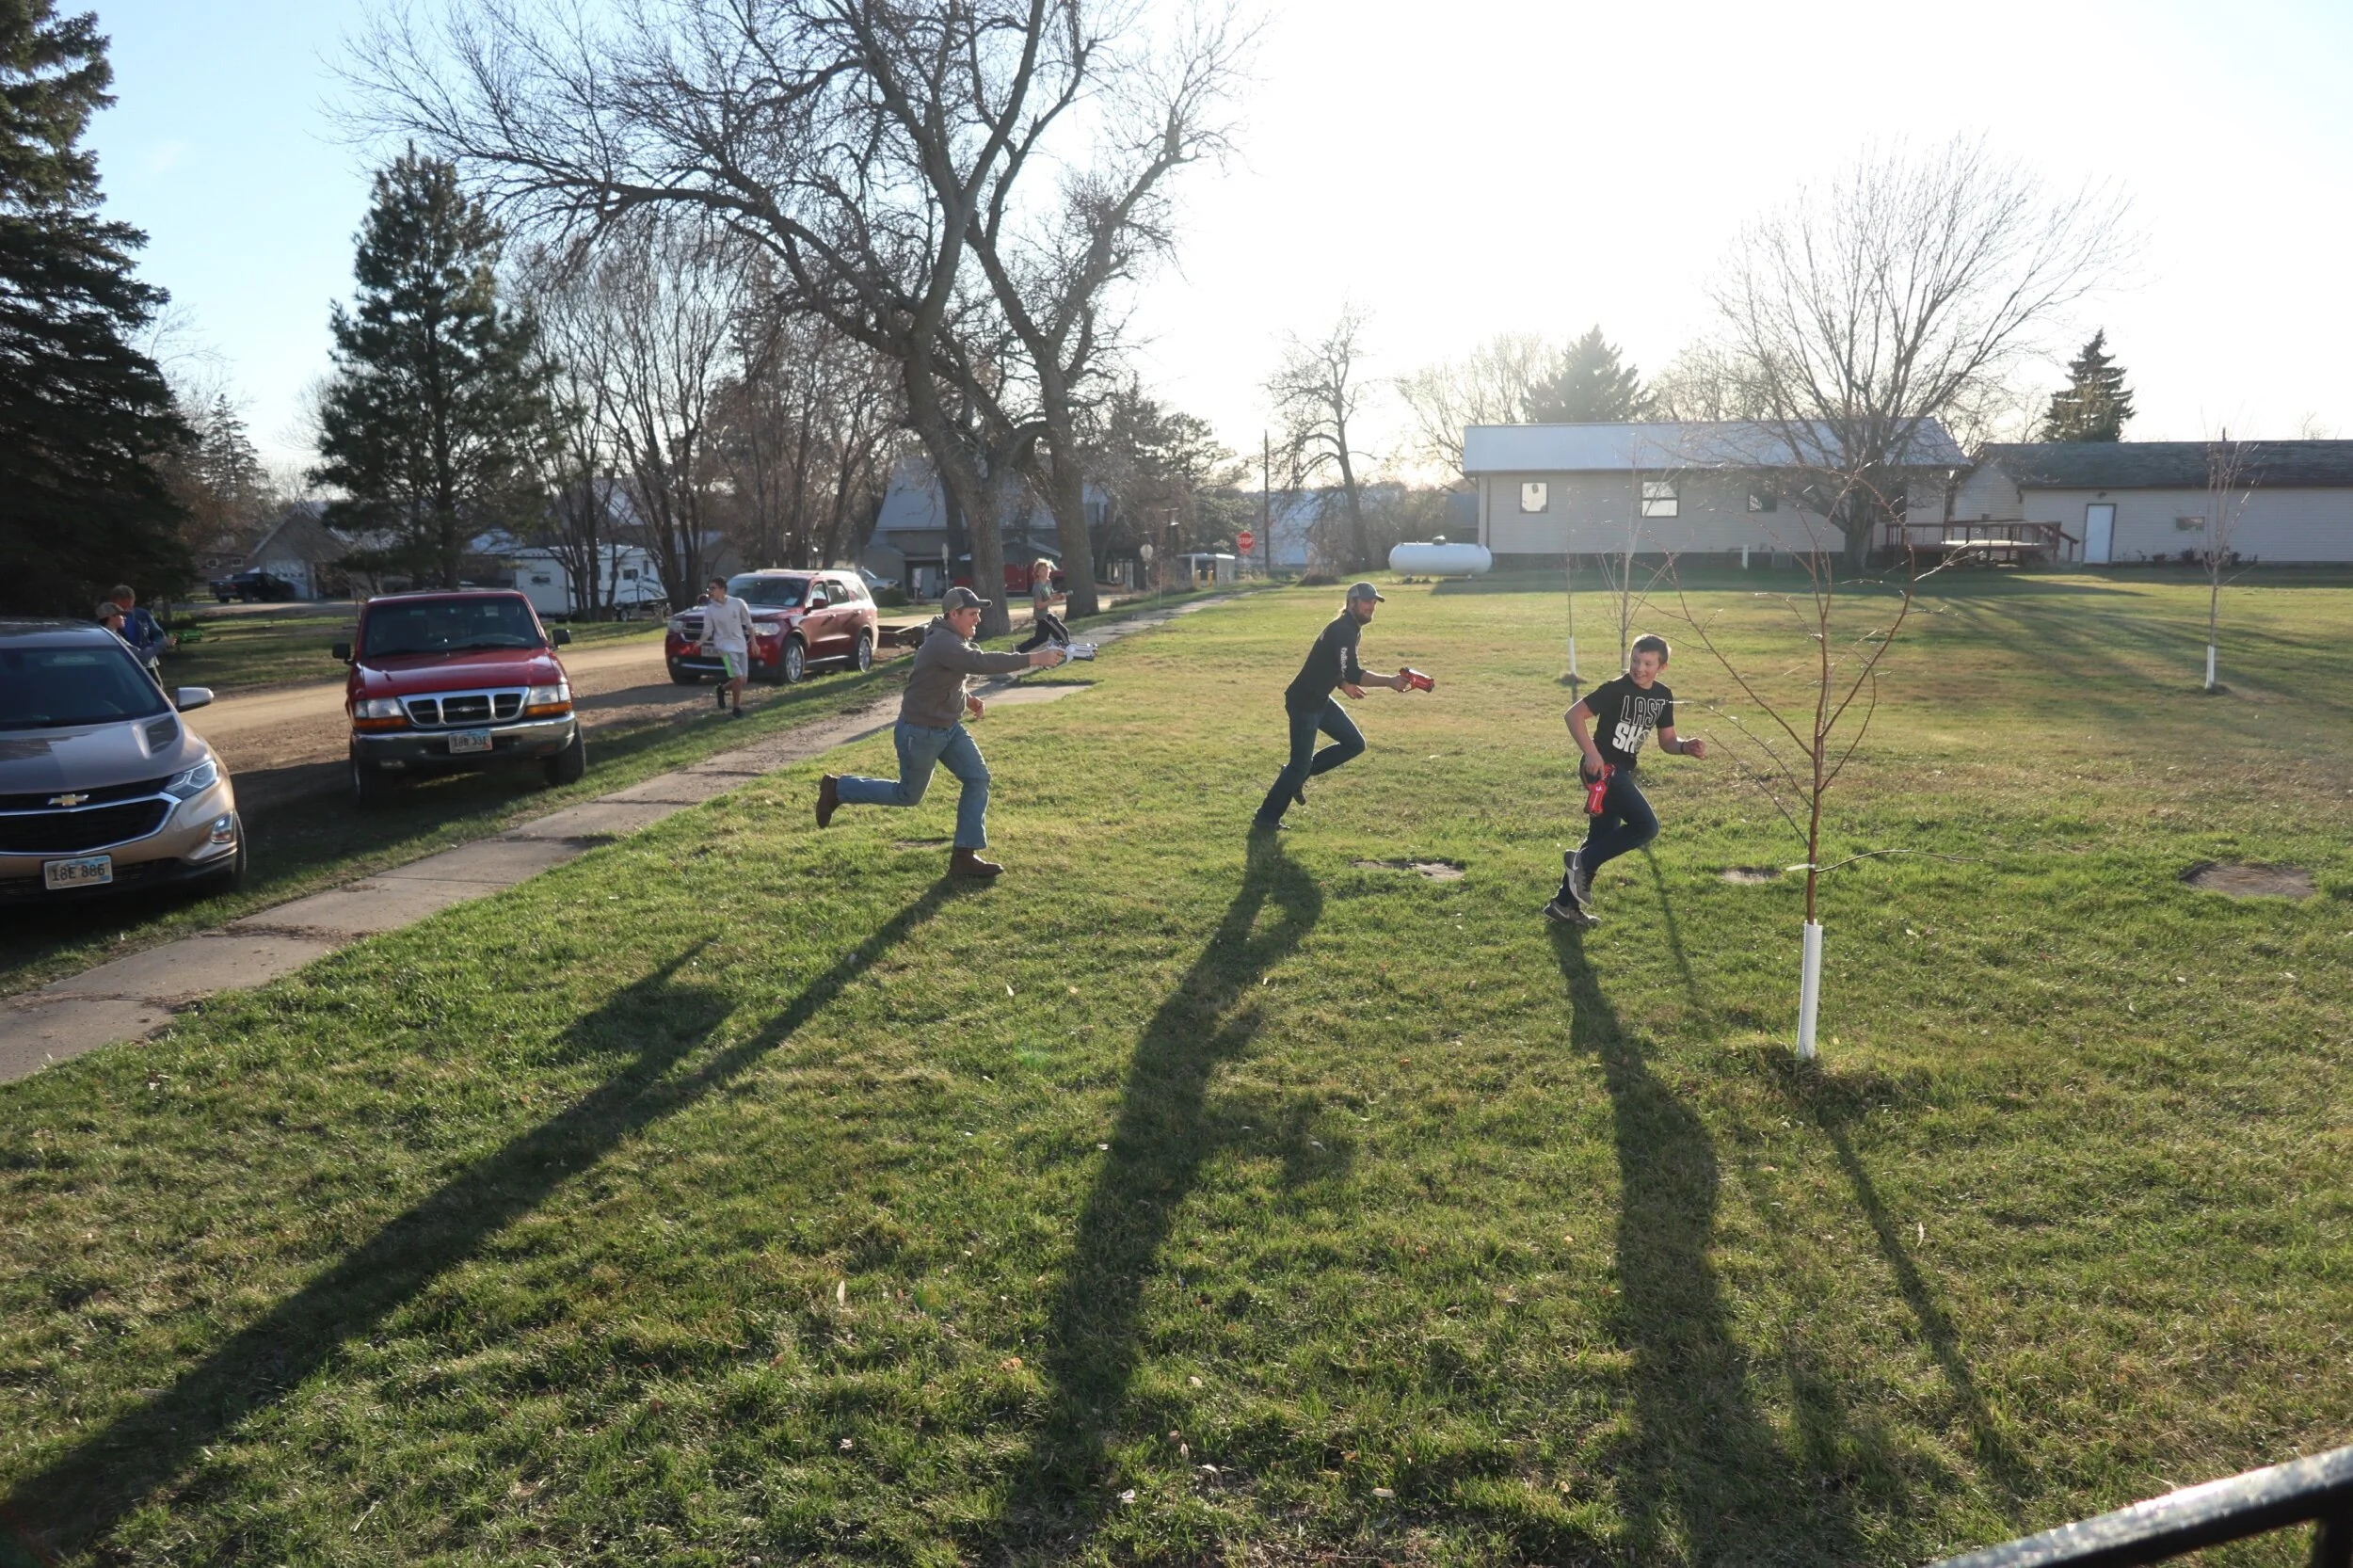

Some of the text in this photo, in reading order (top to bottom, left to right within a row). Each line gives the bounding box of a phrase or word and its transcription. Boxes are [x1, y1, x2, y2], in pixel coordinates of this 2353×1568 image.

[1620, 696, 1665, 728] LAST
[52, 864, 105, 882] 18E 886
